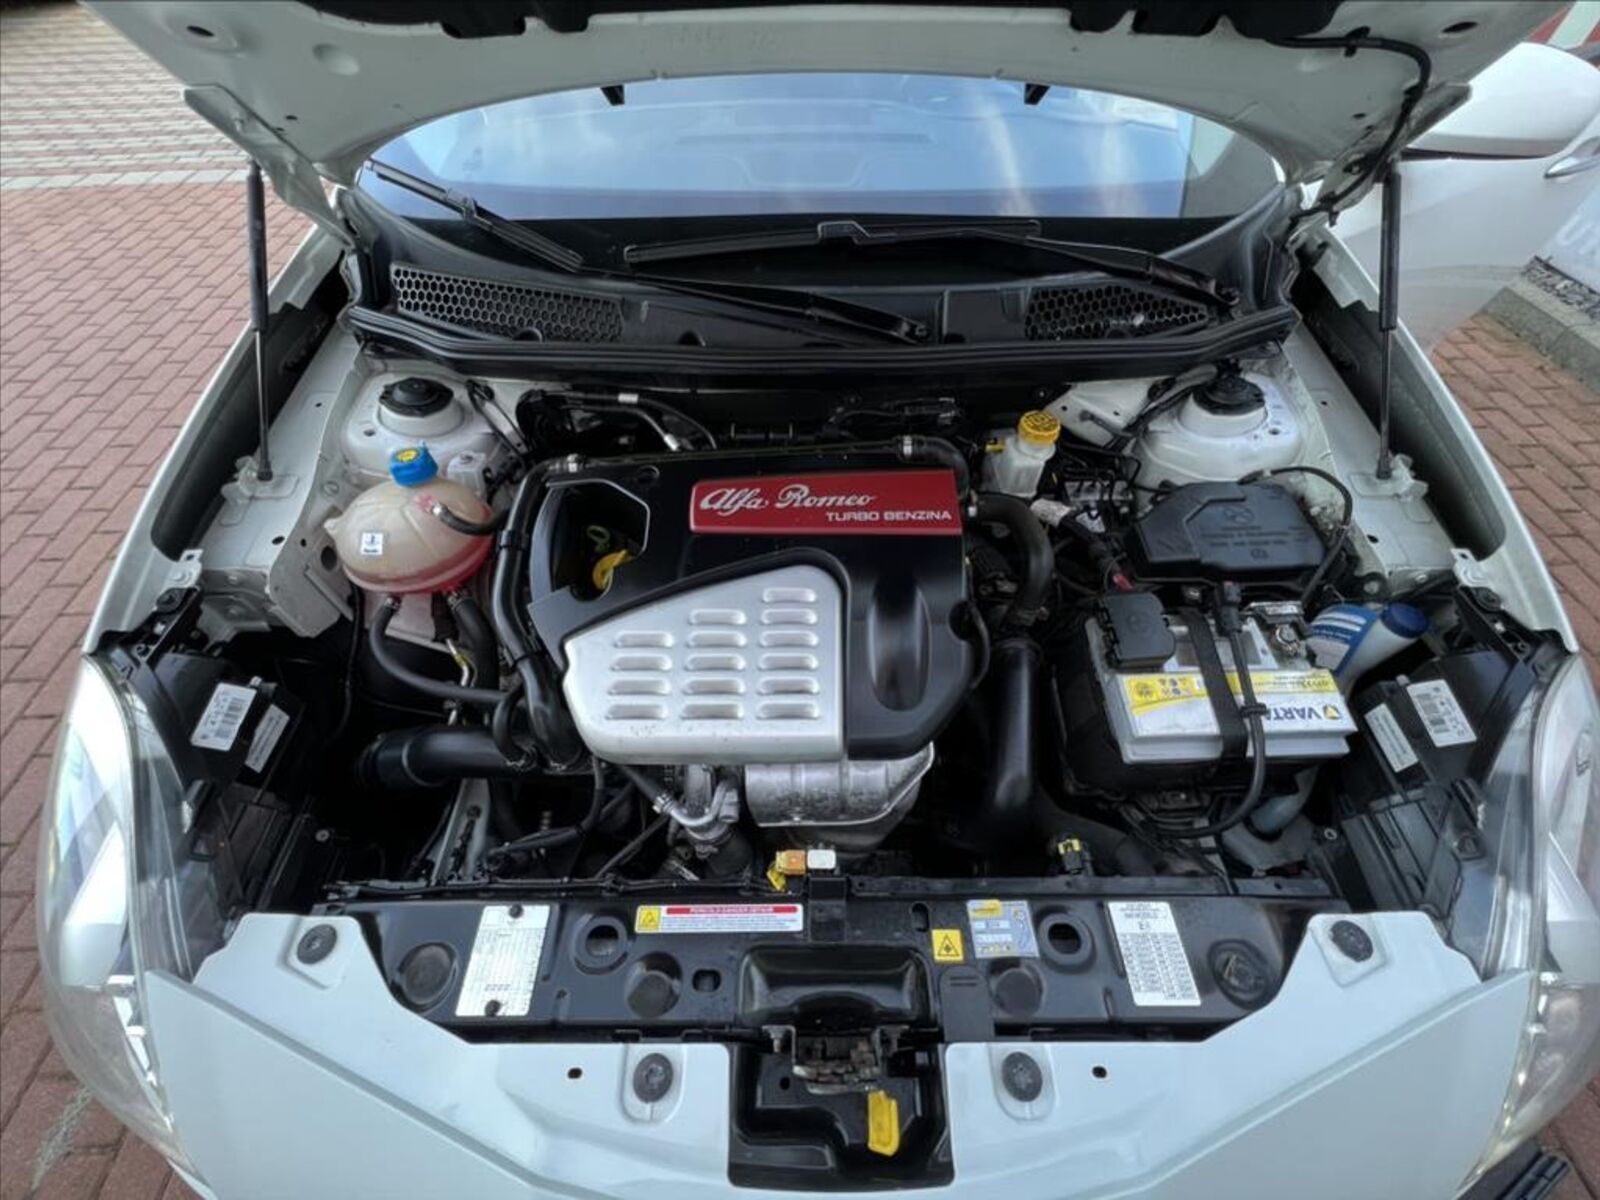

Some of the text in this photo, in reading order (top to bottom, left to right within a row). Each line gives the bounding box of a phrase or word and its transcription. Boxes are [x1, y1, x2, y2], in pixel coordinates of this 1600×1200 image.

[700, 484, 875, 517] Alfa Romeo
[826, 511, 952, 522] TURBO BENZINA
